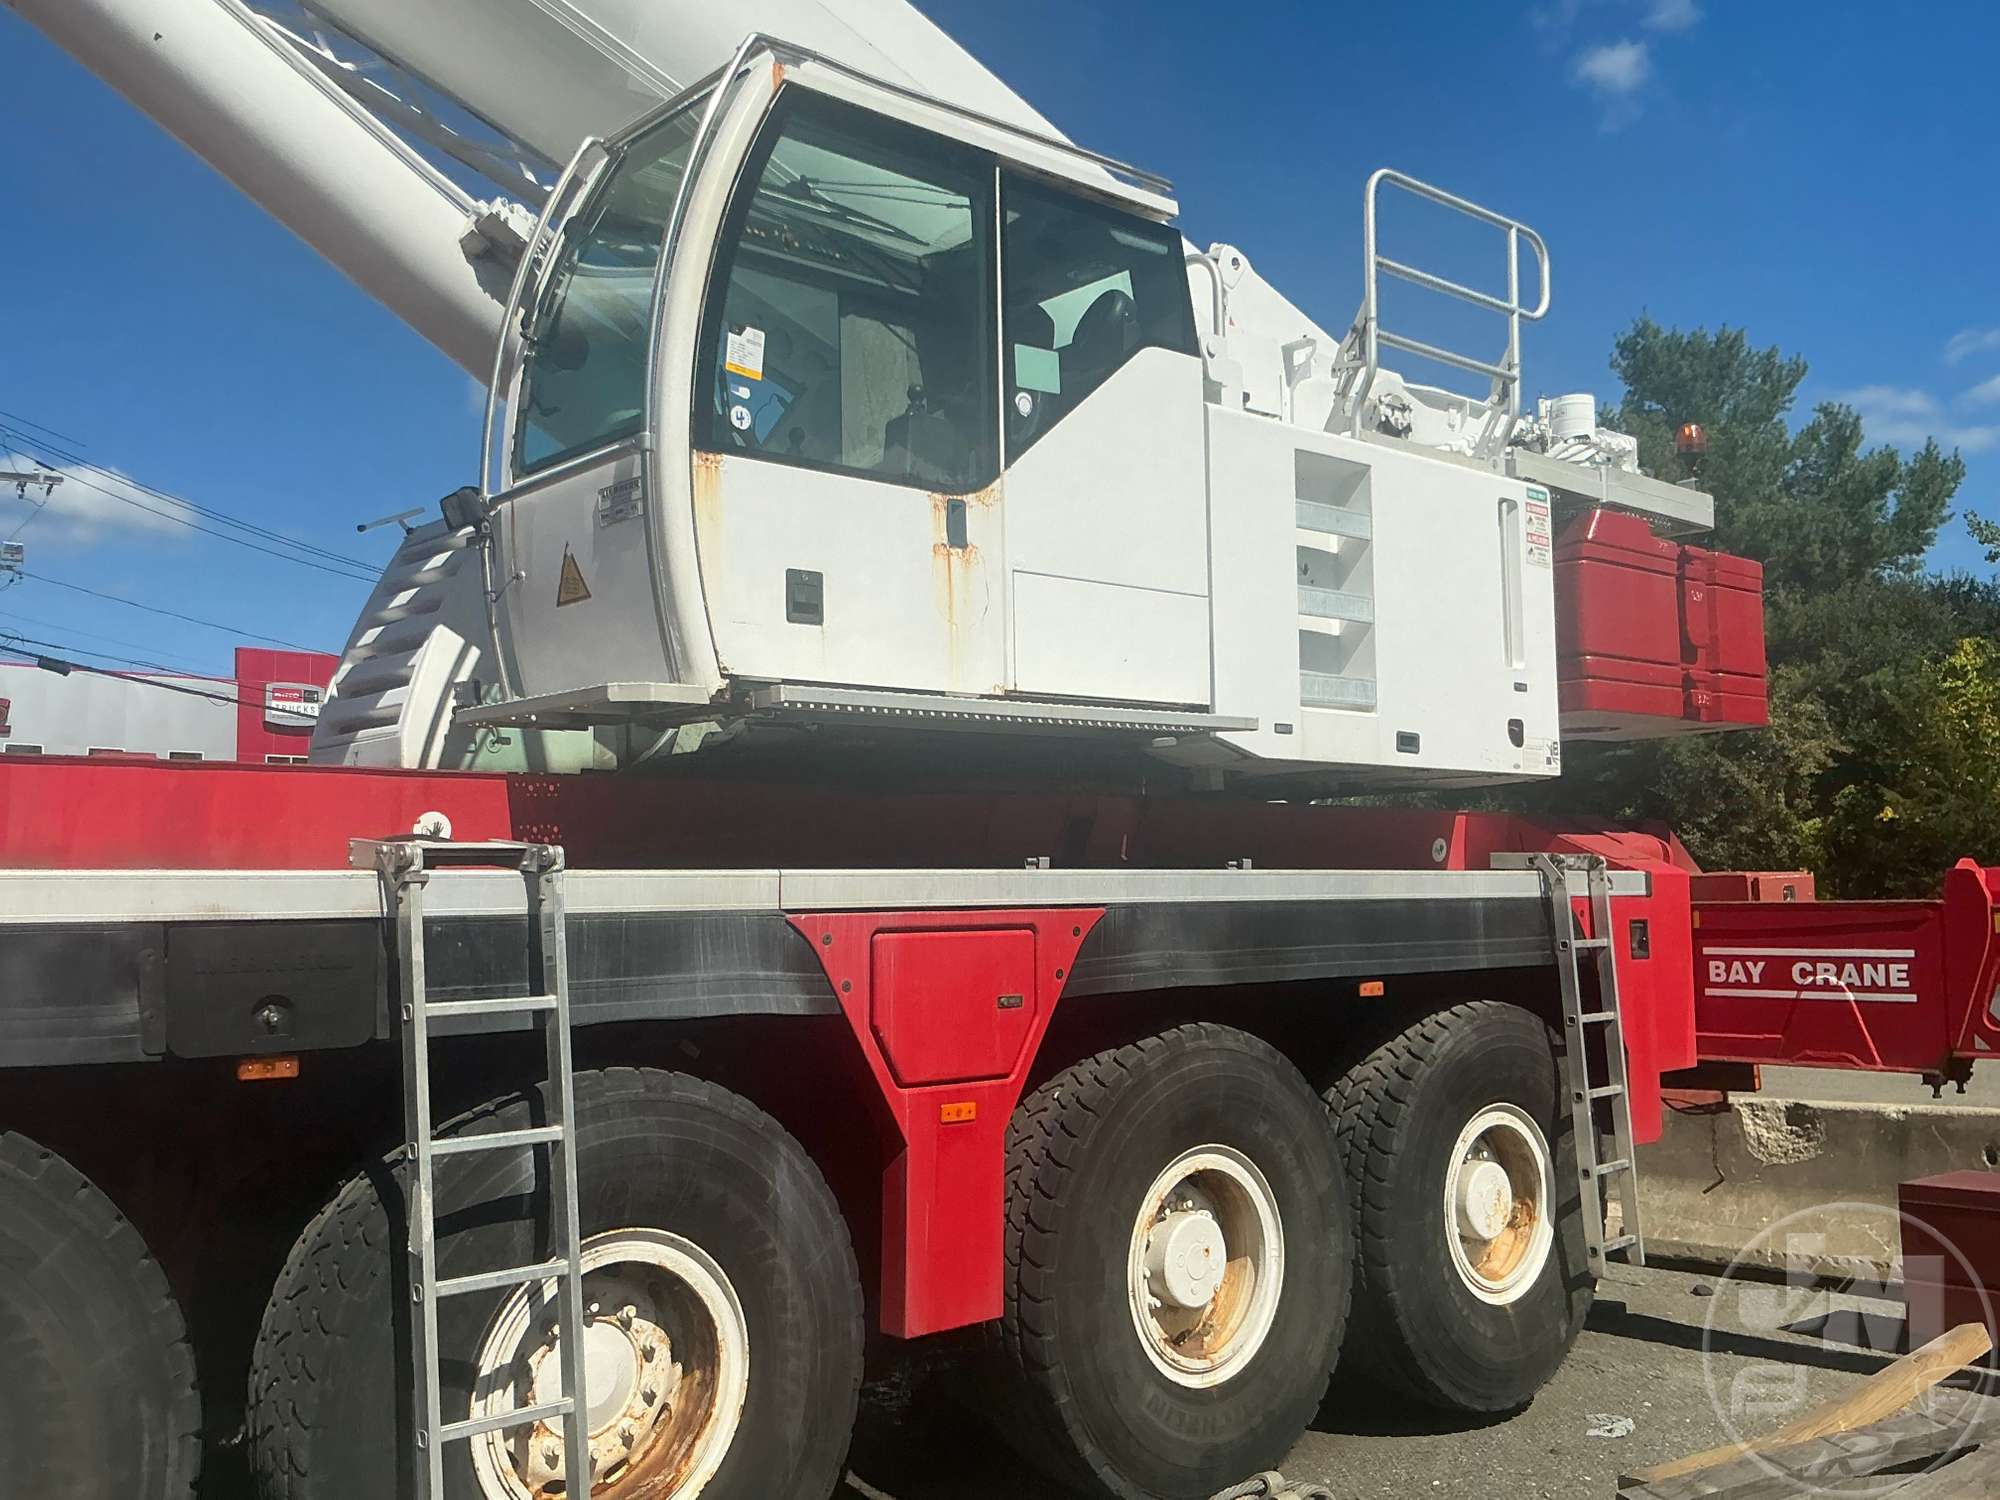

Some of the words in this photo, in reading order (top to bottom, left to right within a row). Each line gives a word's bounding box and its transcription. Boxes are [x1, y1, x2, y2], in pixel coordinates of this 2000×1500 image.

[275, 703, 316, 715] TRUCKS
[1708, 960, 1766, 984] BAY
[1791, 961, 1911, 988] CRANE
